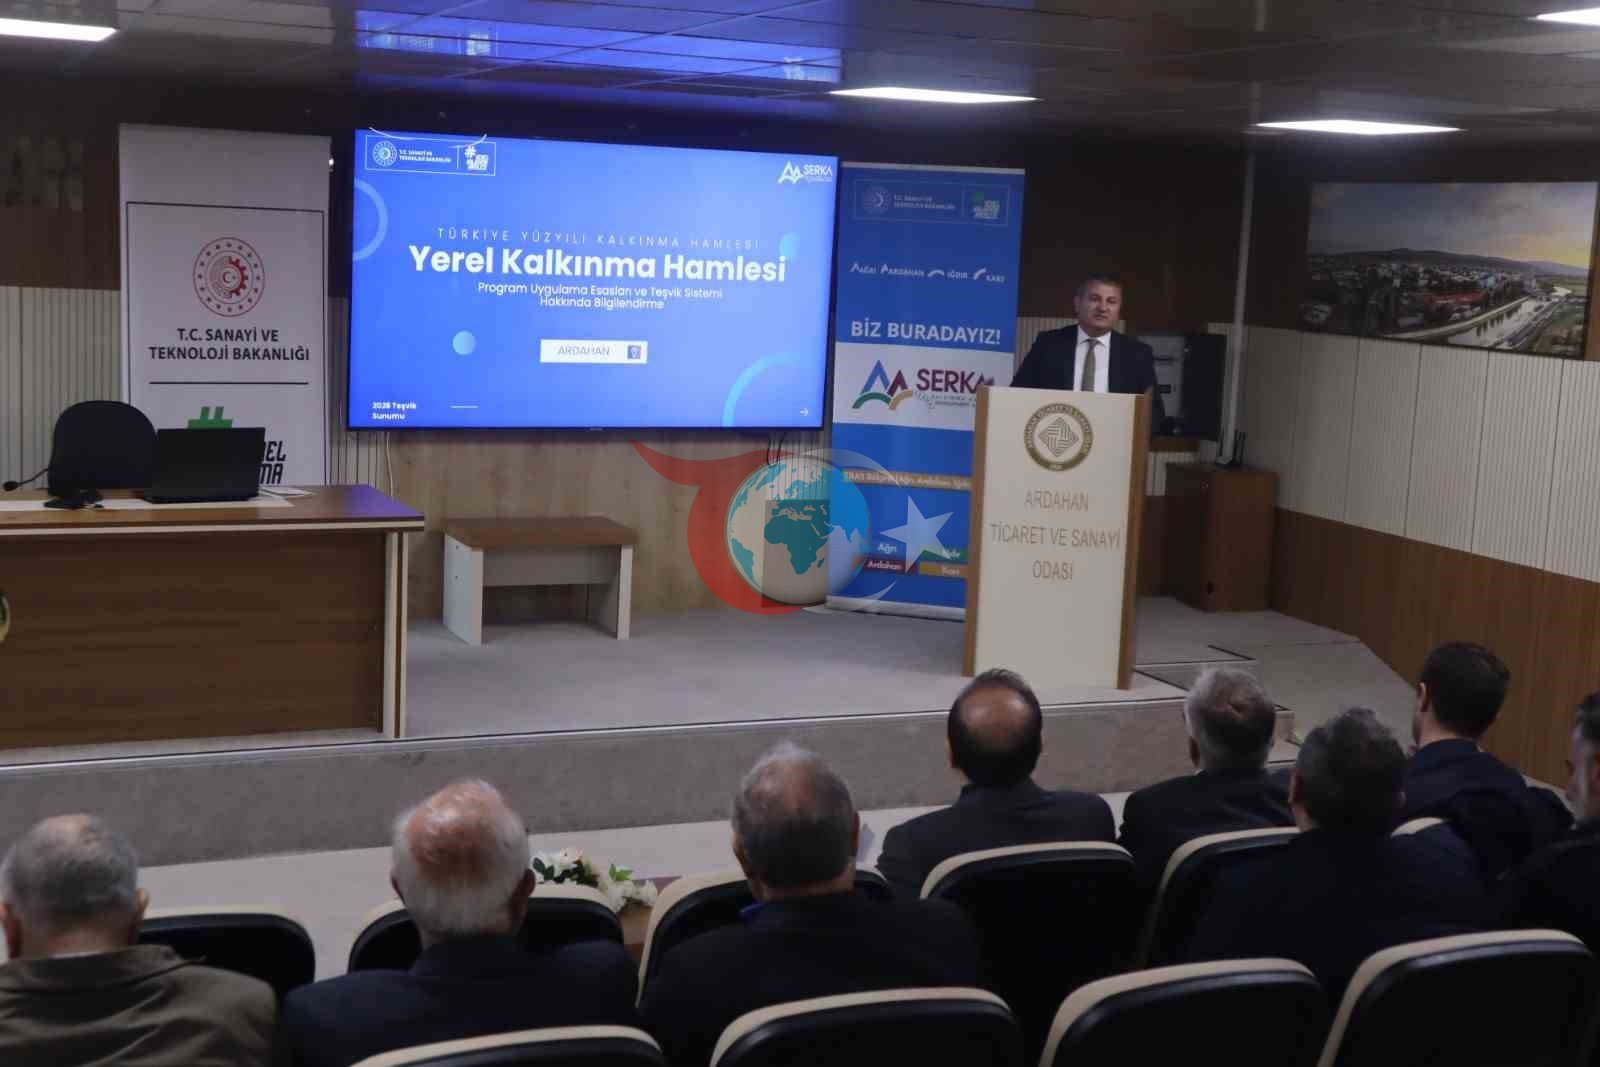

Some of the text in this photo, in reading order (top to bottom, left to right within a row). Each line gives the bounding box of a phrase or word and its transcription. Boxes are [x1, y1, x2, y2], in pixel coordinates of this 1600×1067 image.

[803, 163, 833, 177] SERKA
[408, 244, 786, 282] Yerel Kalkınma Hamlesi
[478, 282, 528, 297] Program
[530, 283, 588, 298] Uygulama
[635, 288, 647, 297] ve
[684, 288, 723, 299] Sistemi
[594, 297, 664, 310] Bilgilendirme
[177, 326, 279, 342] T.C. SANAYİ VE
[851, 317, 1001, 345] BİZ BURADAYIZ!
[148, 344, 310, 361] TEKNOLOJİ BAKANLIĞI
[1024, 489, 1089, 512] ARDAHAN
[989, 521, 1121, 550] TİCARET VE SANAYİ
[1032, 559, 1074, 581] ODASI
